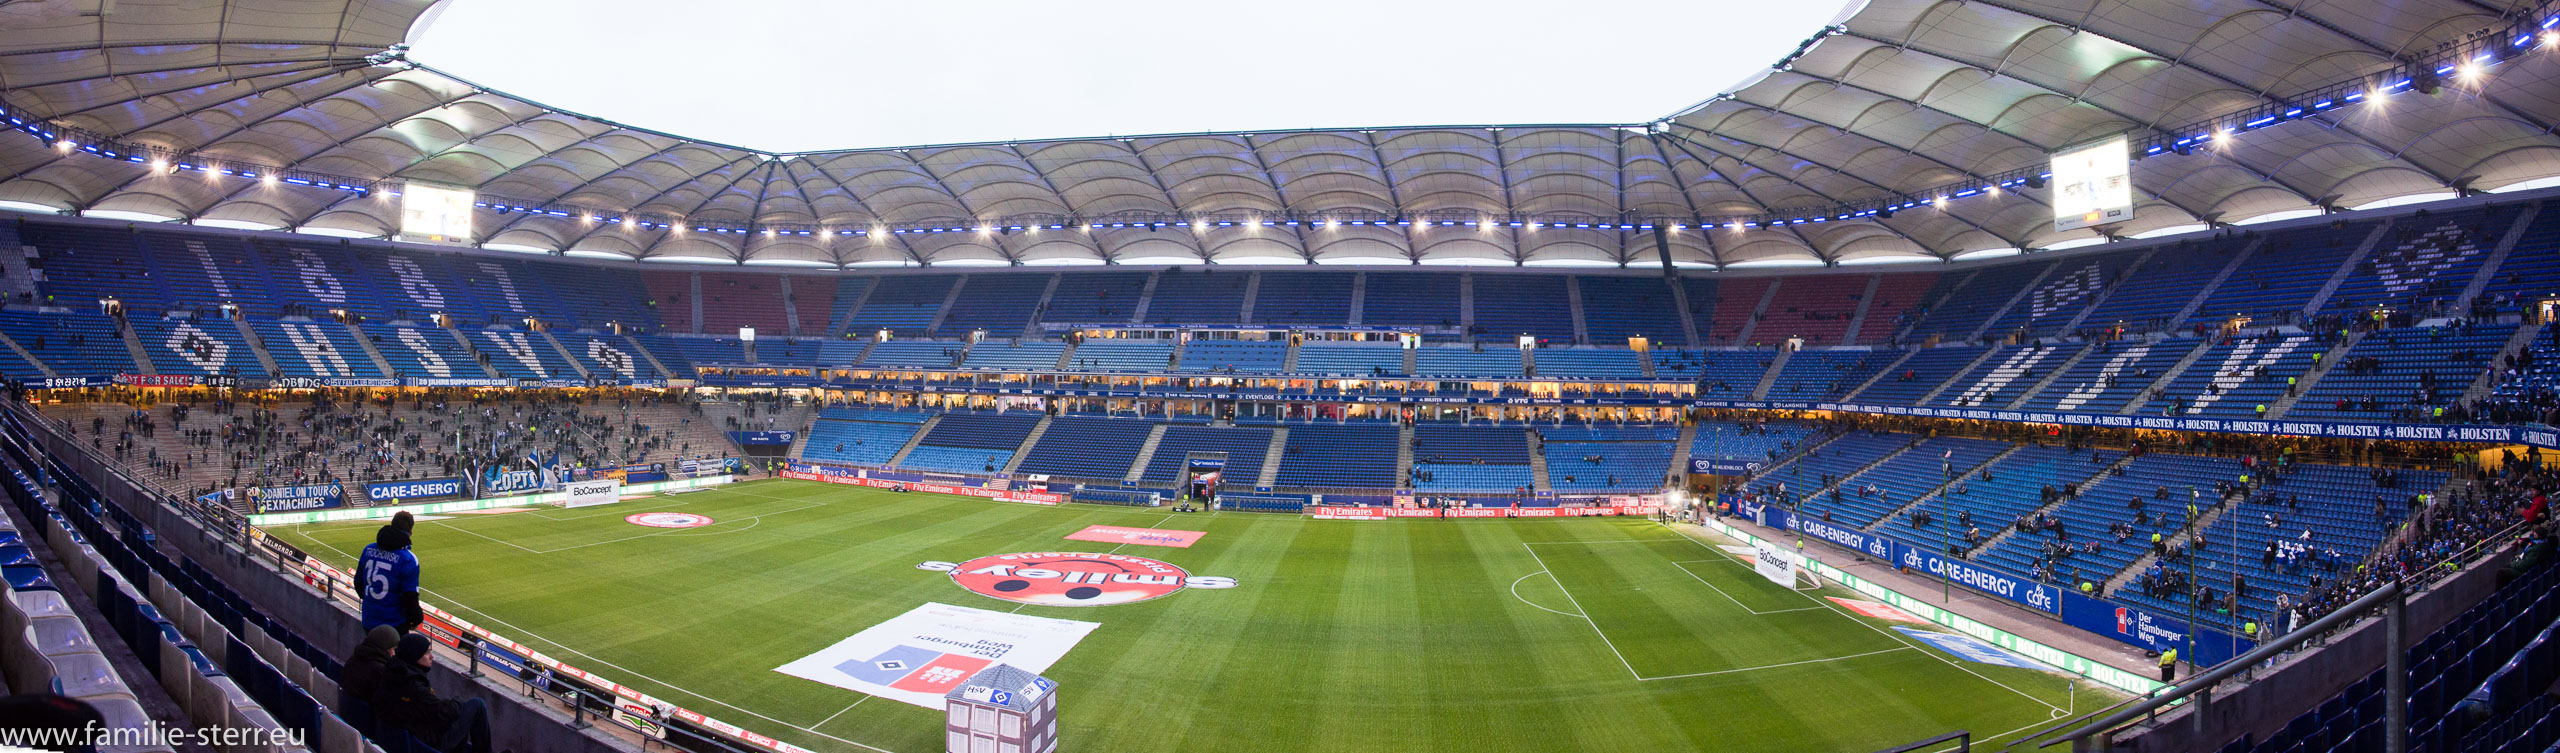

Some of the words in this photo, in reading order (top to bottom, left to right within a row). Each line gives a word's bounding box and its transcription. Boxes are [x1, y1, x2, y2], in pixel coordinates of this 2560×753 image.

[1821, 403, 1836, 411] HOLSTEN
[1842, 404, 1858, 412] HOLSTEN
[1864, 405, 1882, 413] HOLSTEN
[1888, 406, 1906, 415] HOLSTEN
[1913, 407, 1933, 416] HOLSTEN
[1939, 409, 1961, 418] HOLSTEN
[1968, 410, 1990, 419] HOLSTEN
[1998, 412, 2022, 421] HOLSTEN
[2030, 413, 2056, 423] HOLSTEN
[2065, 415, 2093, 425] HOLSTEN
[2102, 416, 2132, 427] HOLSTEN
[2142, 418, 2174, 429] HOLSTEN
[2185, 419, 2220, 431] HOLSTEN
[2232, 421, 2269, 433] HOLSTEN
[2282, 423, 2322, 435] HOLSTEN
[2337, 424, 2380, 437] HOLSTEN
[2396, 426, 2442, 440] HOLSTEN
[2460, 428, 2510, 441] HOLSTEN
[2528, 431, 2557, 447] HOLSTEN
[783, 471, 792, 479] Fly
[793, 472, 817, 481] Emirates
[824, 475, 834, 483] Fly
[835, 476, 860, 485] Emirates
[371, 479, 460, 499] CARE-ENERGY
[867, 479, 877, 488] Fly
[913, 483, 923, 491] Fly
[924, 485, 954, 494] Emirates
[267, 488, 295, 499] DANIEL
[295, 487, 306, 498] ON
[308, 485, 329, 497] TOUR
[573, 484, 612, 496] BoConcept
[961, 488, 973, 496] Fly
[974, 489, 1004, 498] Emirates
[1012, 491, 1024, 500] Fly
[1025, 492, 1057, 501] Emirates
[1321, 507, 1335, 516] Fly
[1336, 508, 1373, 516] Emirates
[1382, 508, 1397, 517] Fly
[1398, 508, 1434, 516] Emirates
[1445, 508, 1459, 517] Fly
[1459, 508, 1495, 517] Emirates
[1504, 508, 1518, 517] Fly
[1519, 508, 1555, 517] Emirates
[1565, 507, 1578, 517] Fly
[1579, 507, 1614, 515] Emirates
[1804, 520, 1864, 549] CARE-ENERGY
[264, 537, 294, 556] BELMONDO
[1110, 554, 1175, 573] Pizza
[1759, 547, 1788, 572] BoConcept
[365, 559, 393, 600] 15
[916, 560, 1239, 589] Smiley's
[1928, 557, 2017, 598] CARE-ENERGY
[2138, 612, 2152, 623] Der
[1953, 614, 1994, 643] HOLSTEN
[2138, 621, 2182, 642] Hamburger
[2138, 630, 2155, 646] Weg
[2016, 636, 2065, 668] HOLSTEN
[2091, 663, 2150, 698] HOLSTEN
[967, 686, 987, 694] HSV
[678, 707, 700, 722] tipico
[712, 719, 734, 734] tipico
[747, 731, 770, 746] tipico
